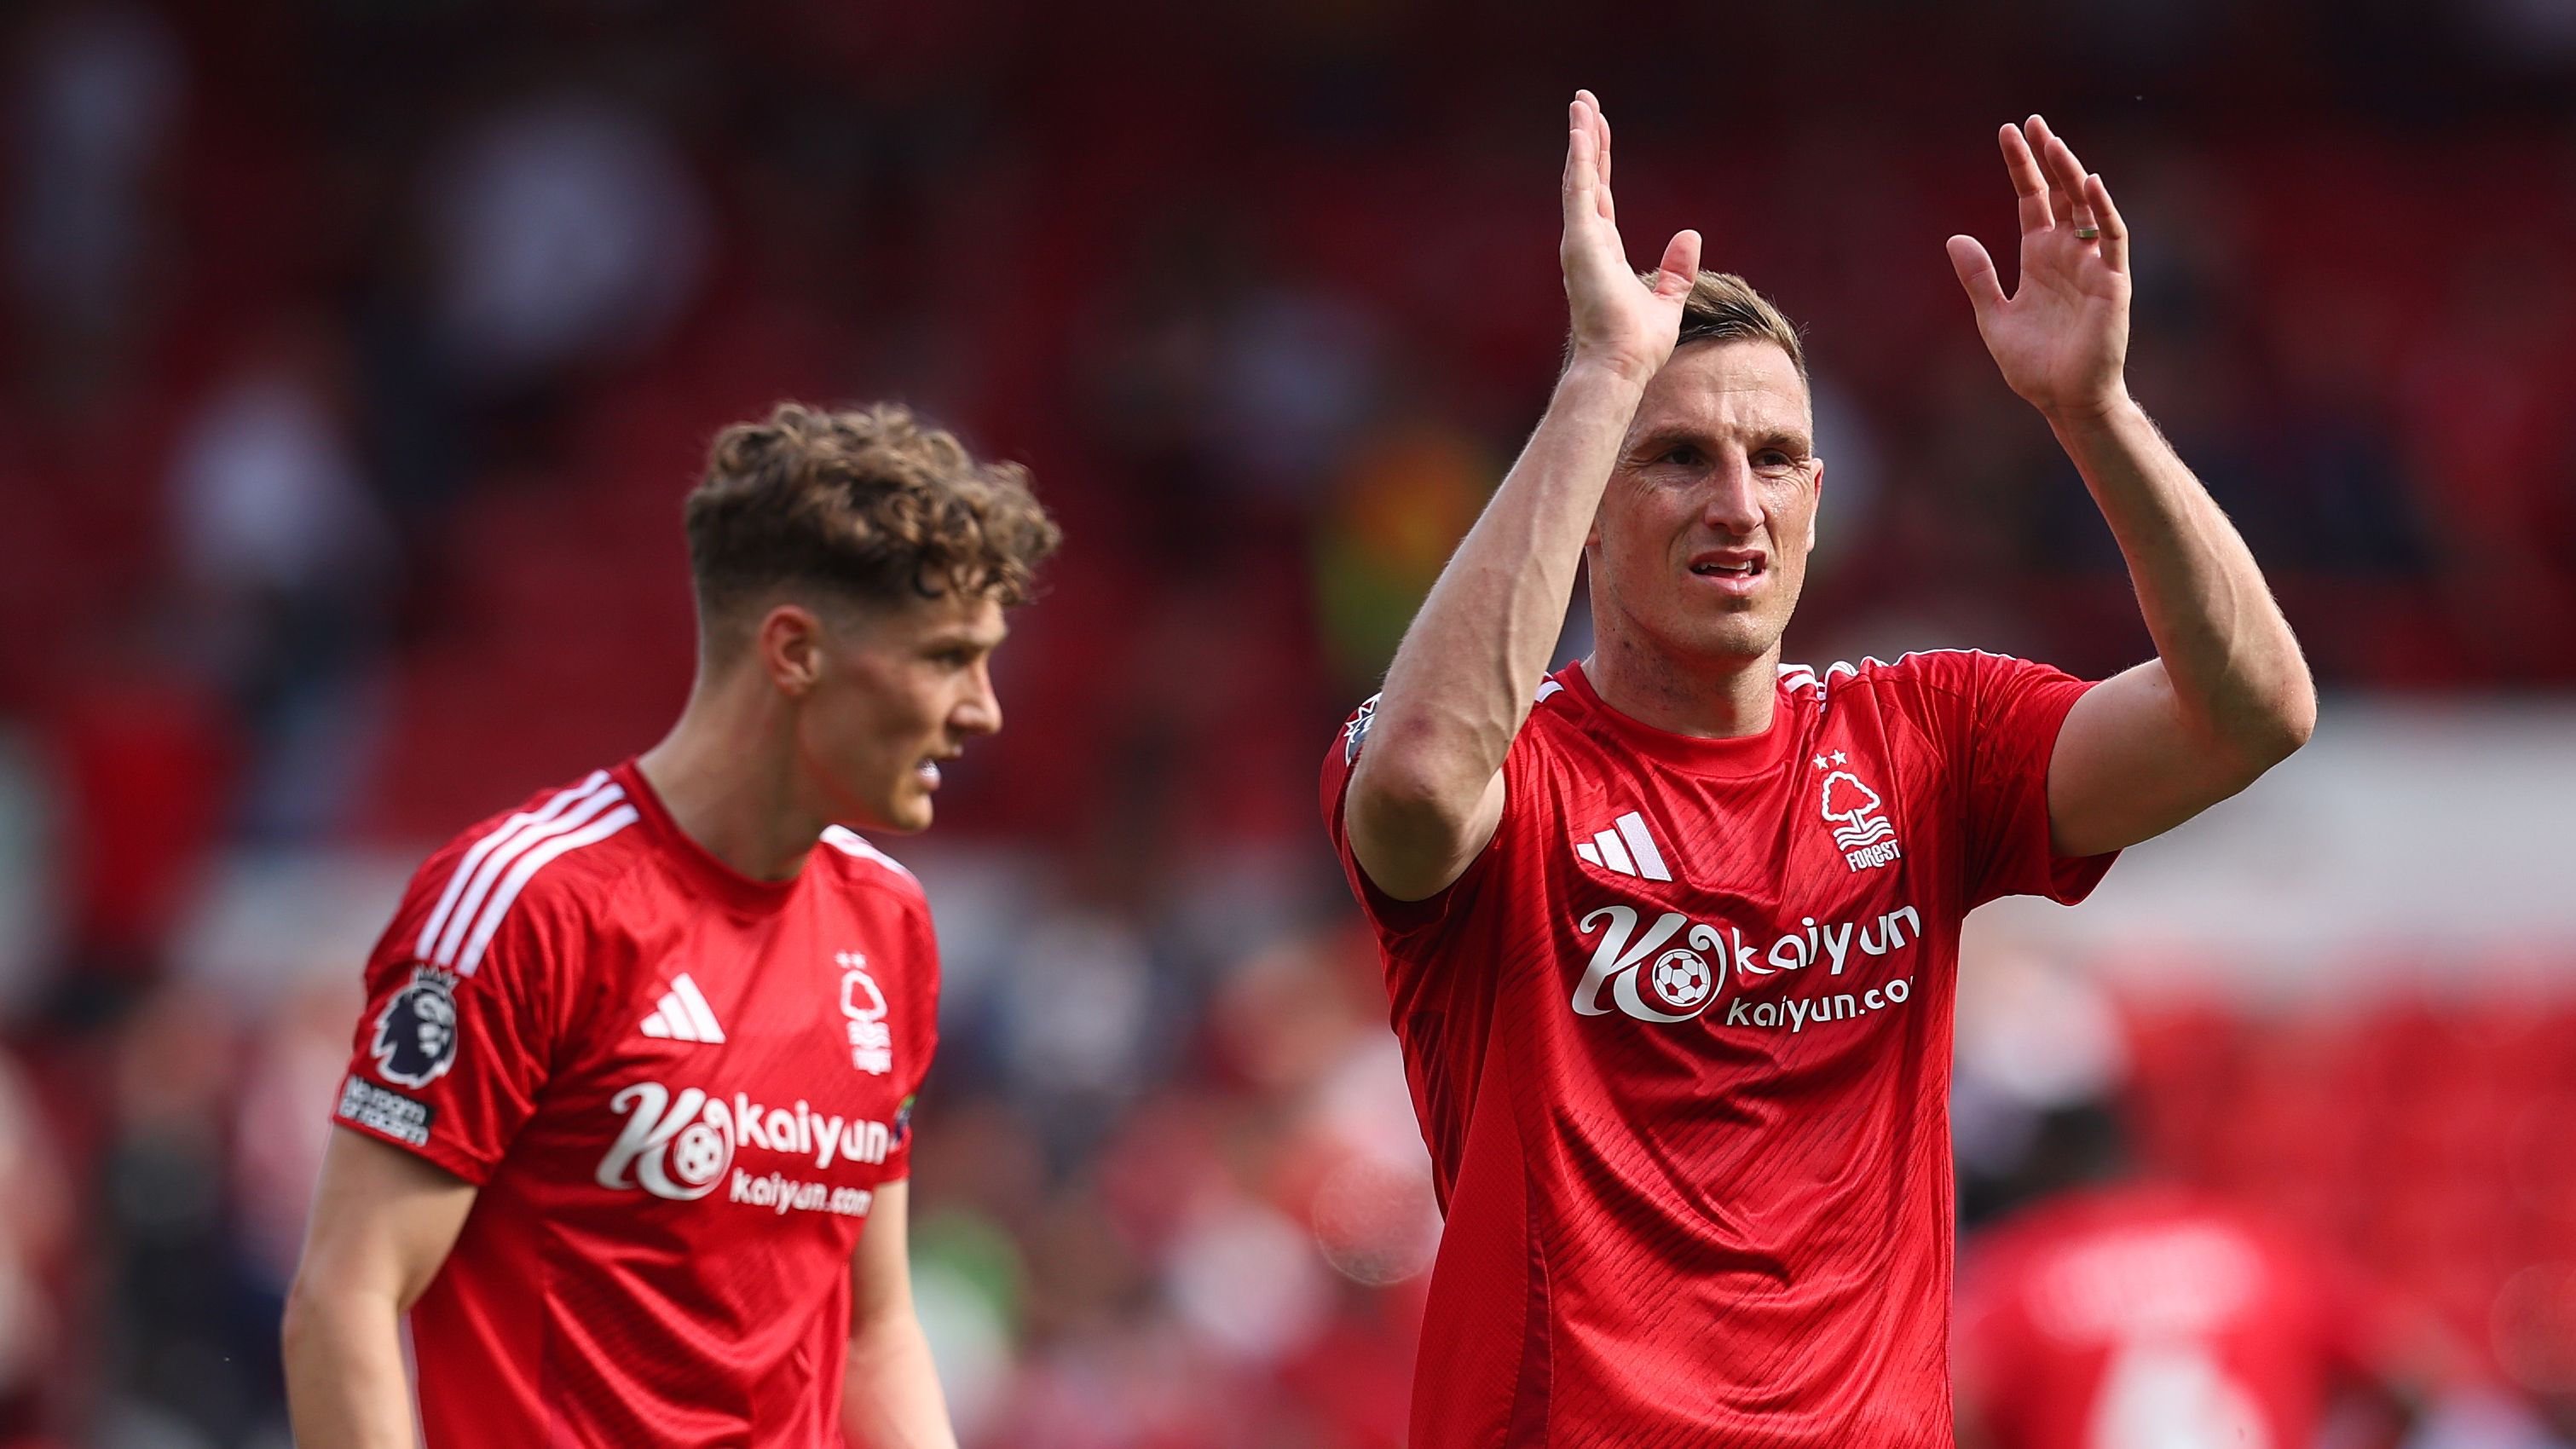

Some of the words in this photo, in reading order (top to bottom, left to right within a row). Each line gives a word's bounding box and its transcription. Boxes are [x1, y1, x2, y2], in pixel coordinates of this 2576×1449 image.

[1731, 905, 1920, 975] kaiyun
[1726, 976, 1914, 1033] kaiyun.co
[734, 1091, 889, 1169] kaiyun
[730, 1167, 874, 1216] kaiyun.com
